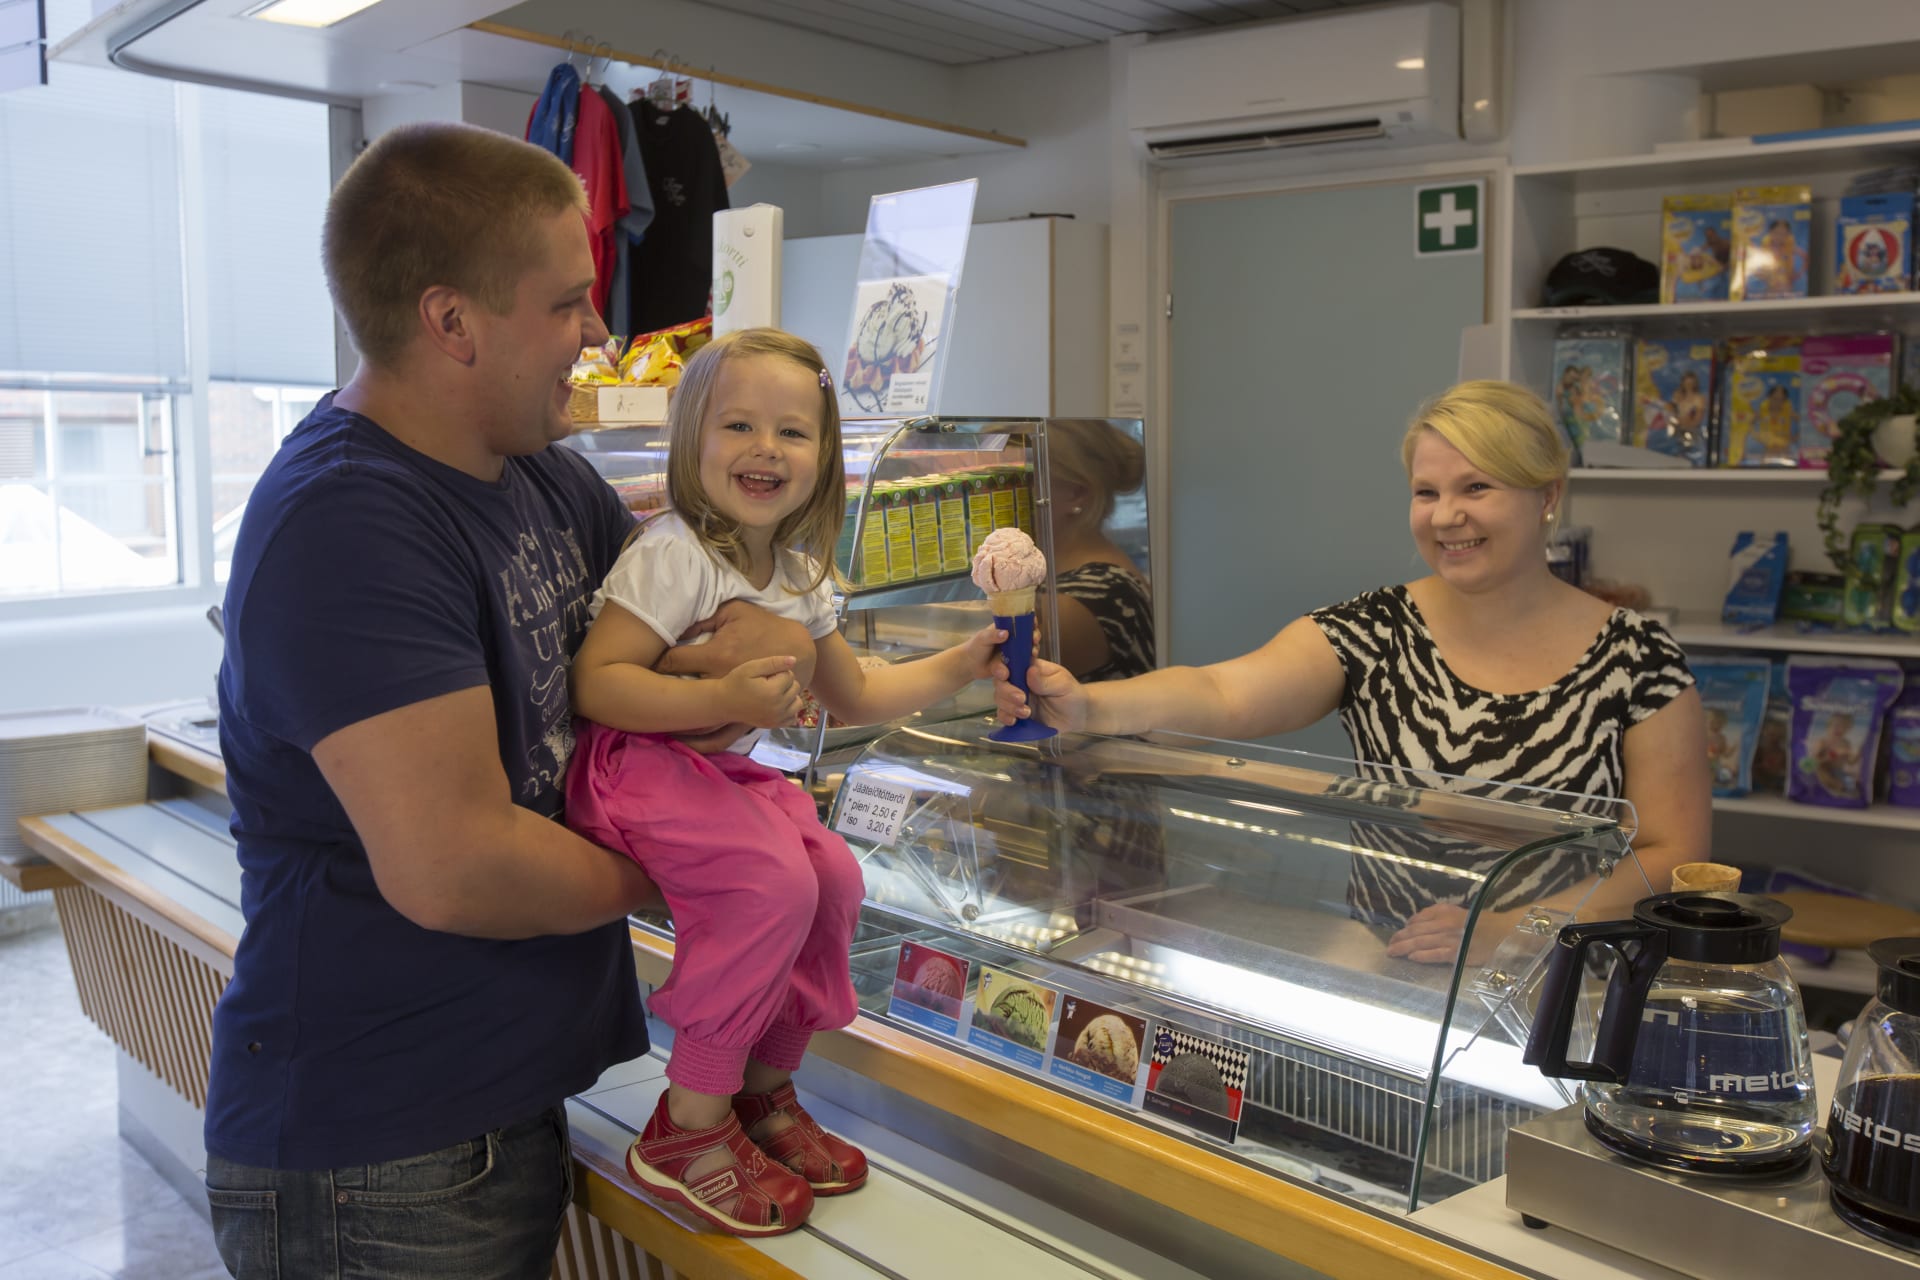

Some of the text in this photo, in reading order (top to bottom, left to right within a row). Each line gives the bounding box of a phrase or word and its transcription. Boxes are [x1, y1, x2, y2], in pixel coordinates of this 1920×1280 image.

[852, 783, 906, 804] Jäätelötötteröt
[850, 800, 898, 821] pieni 2,50 €
[846, 812, 893, 836] iso 3,20 €
